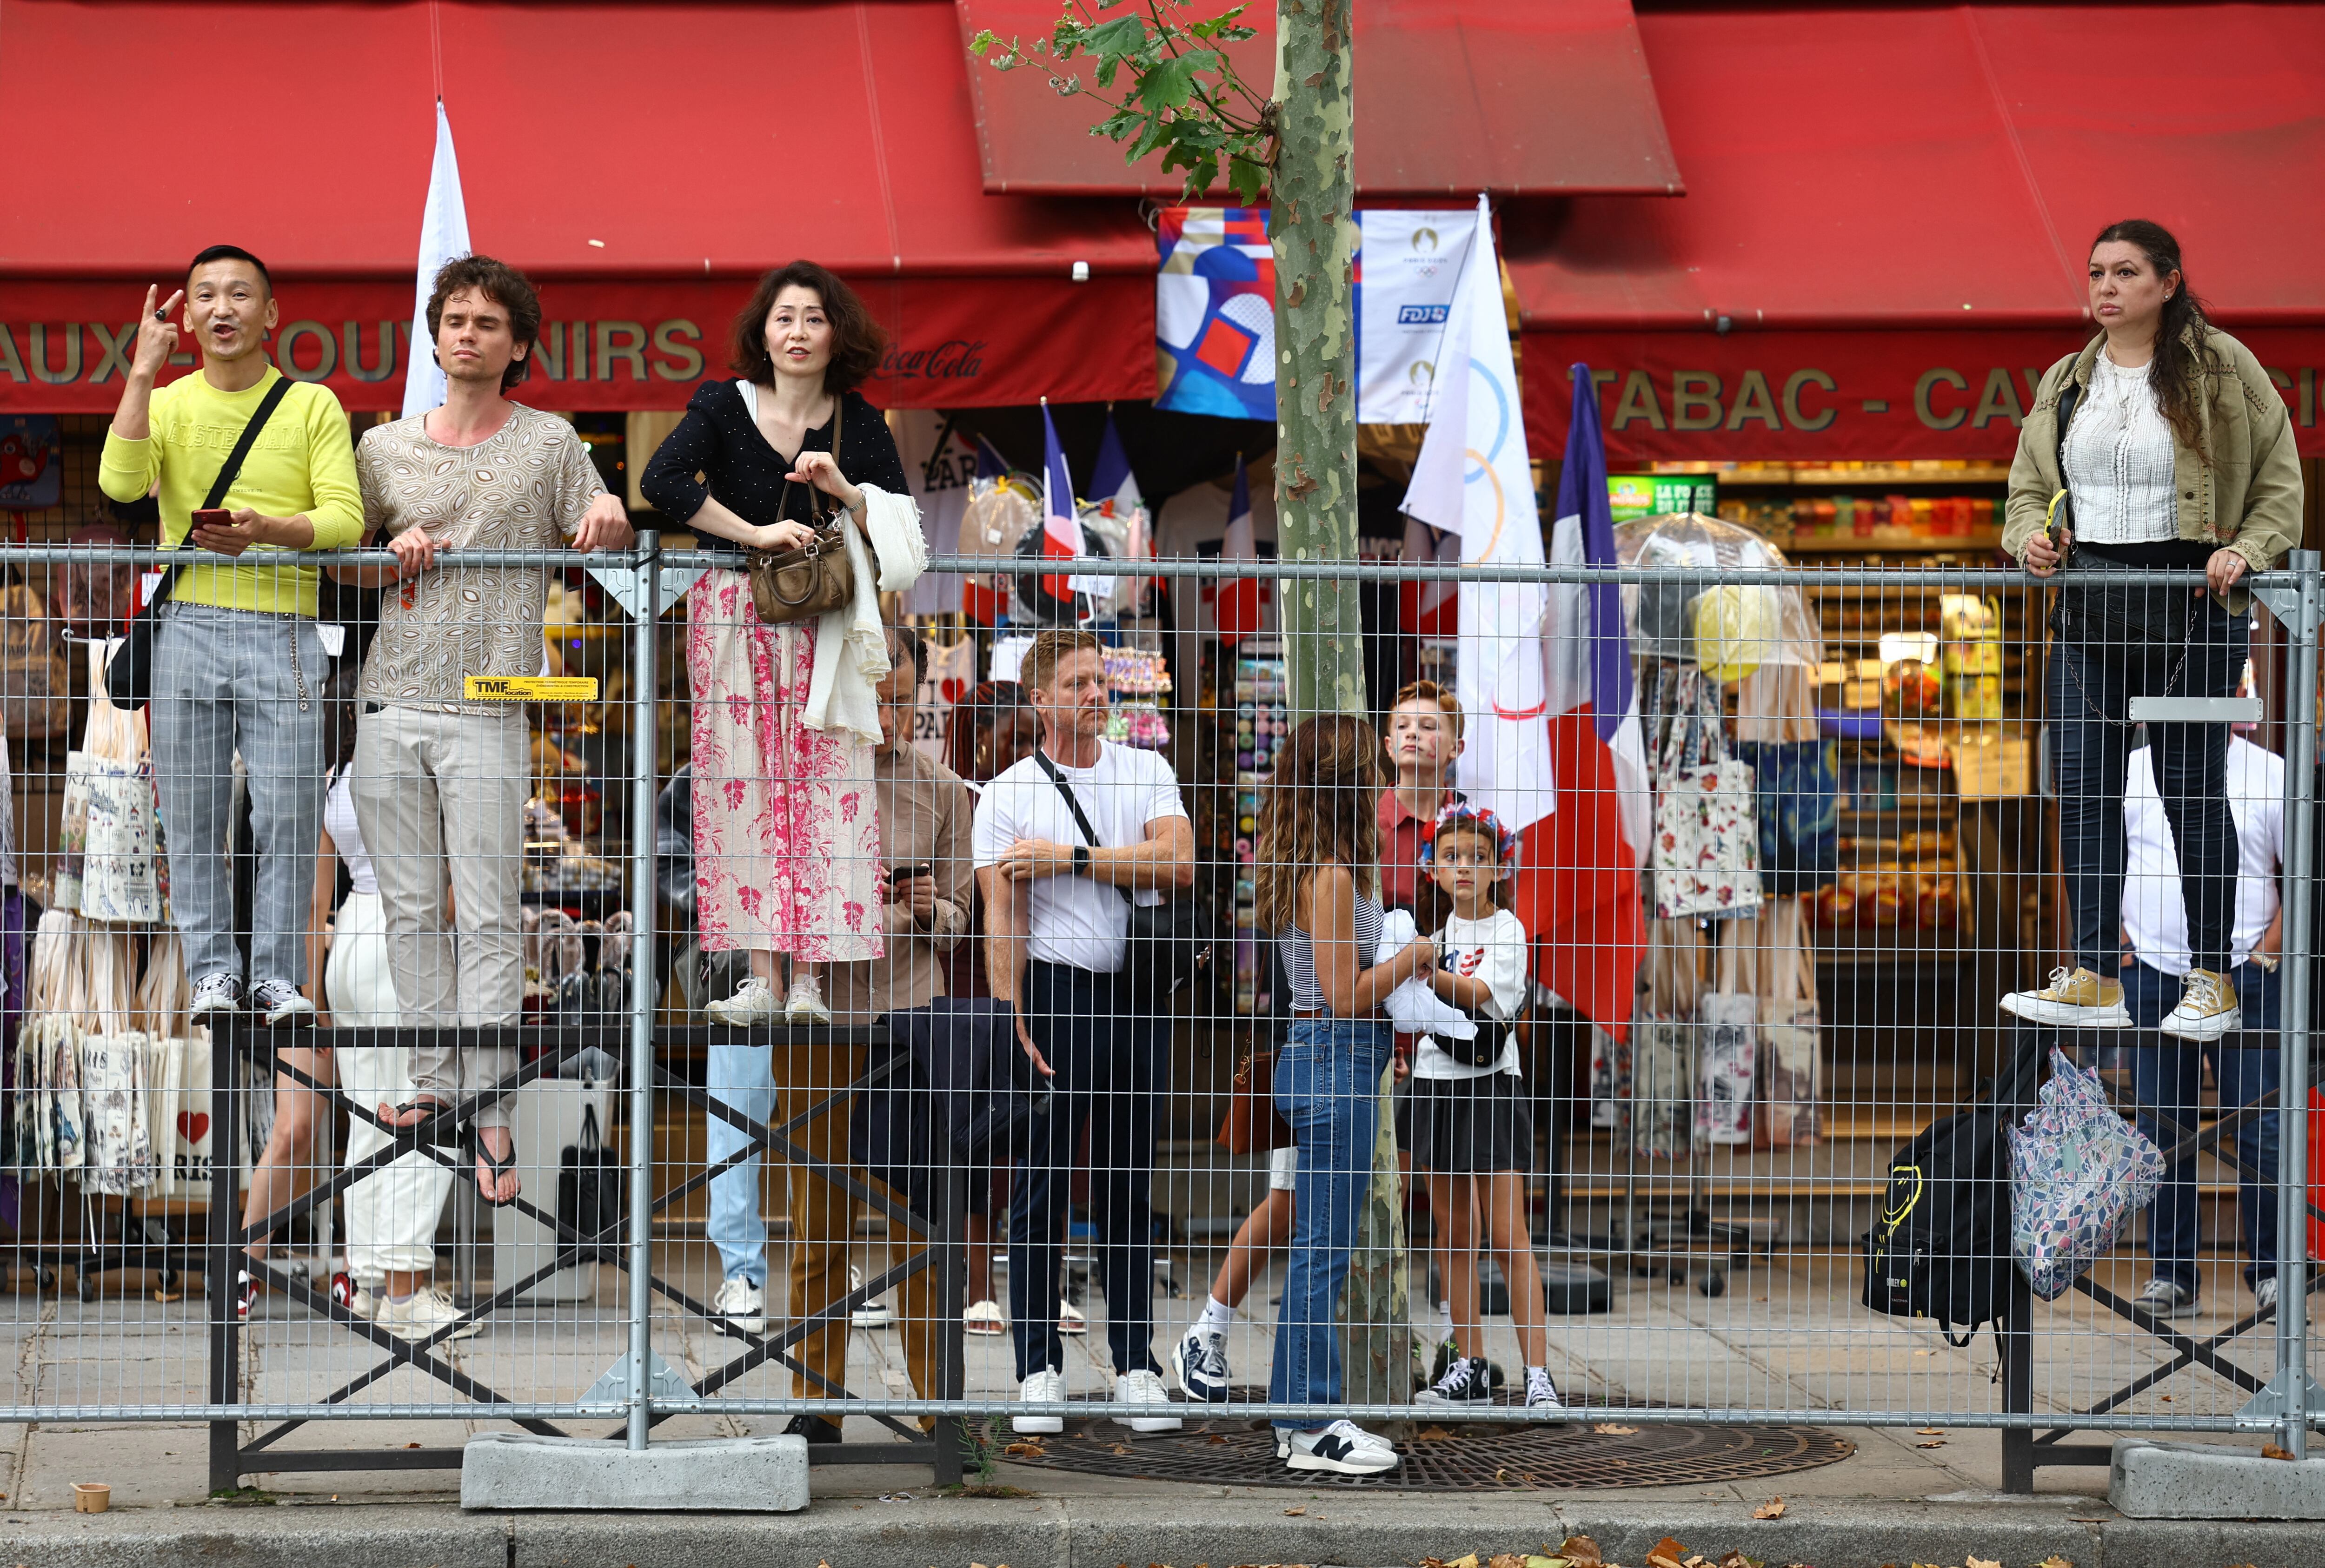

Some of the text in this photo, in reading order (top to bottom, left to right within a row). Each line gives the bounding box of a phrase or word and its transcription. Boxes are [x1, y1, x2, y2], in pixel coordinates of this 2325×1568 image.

[1400, 307, 1432, 322] FDJ
[1674, 484, 1714, 499] FOCE
[475, 681, 509, 693] TMF
